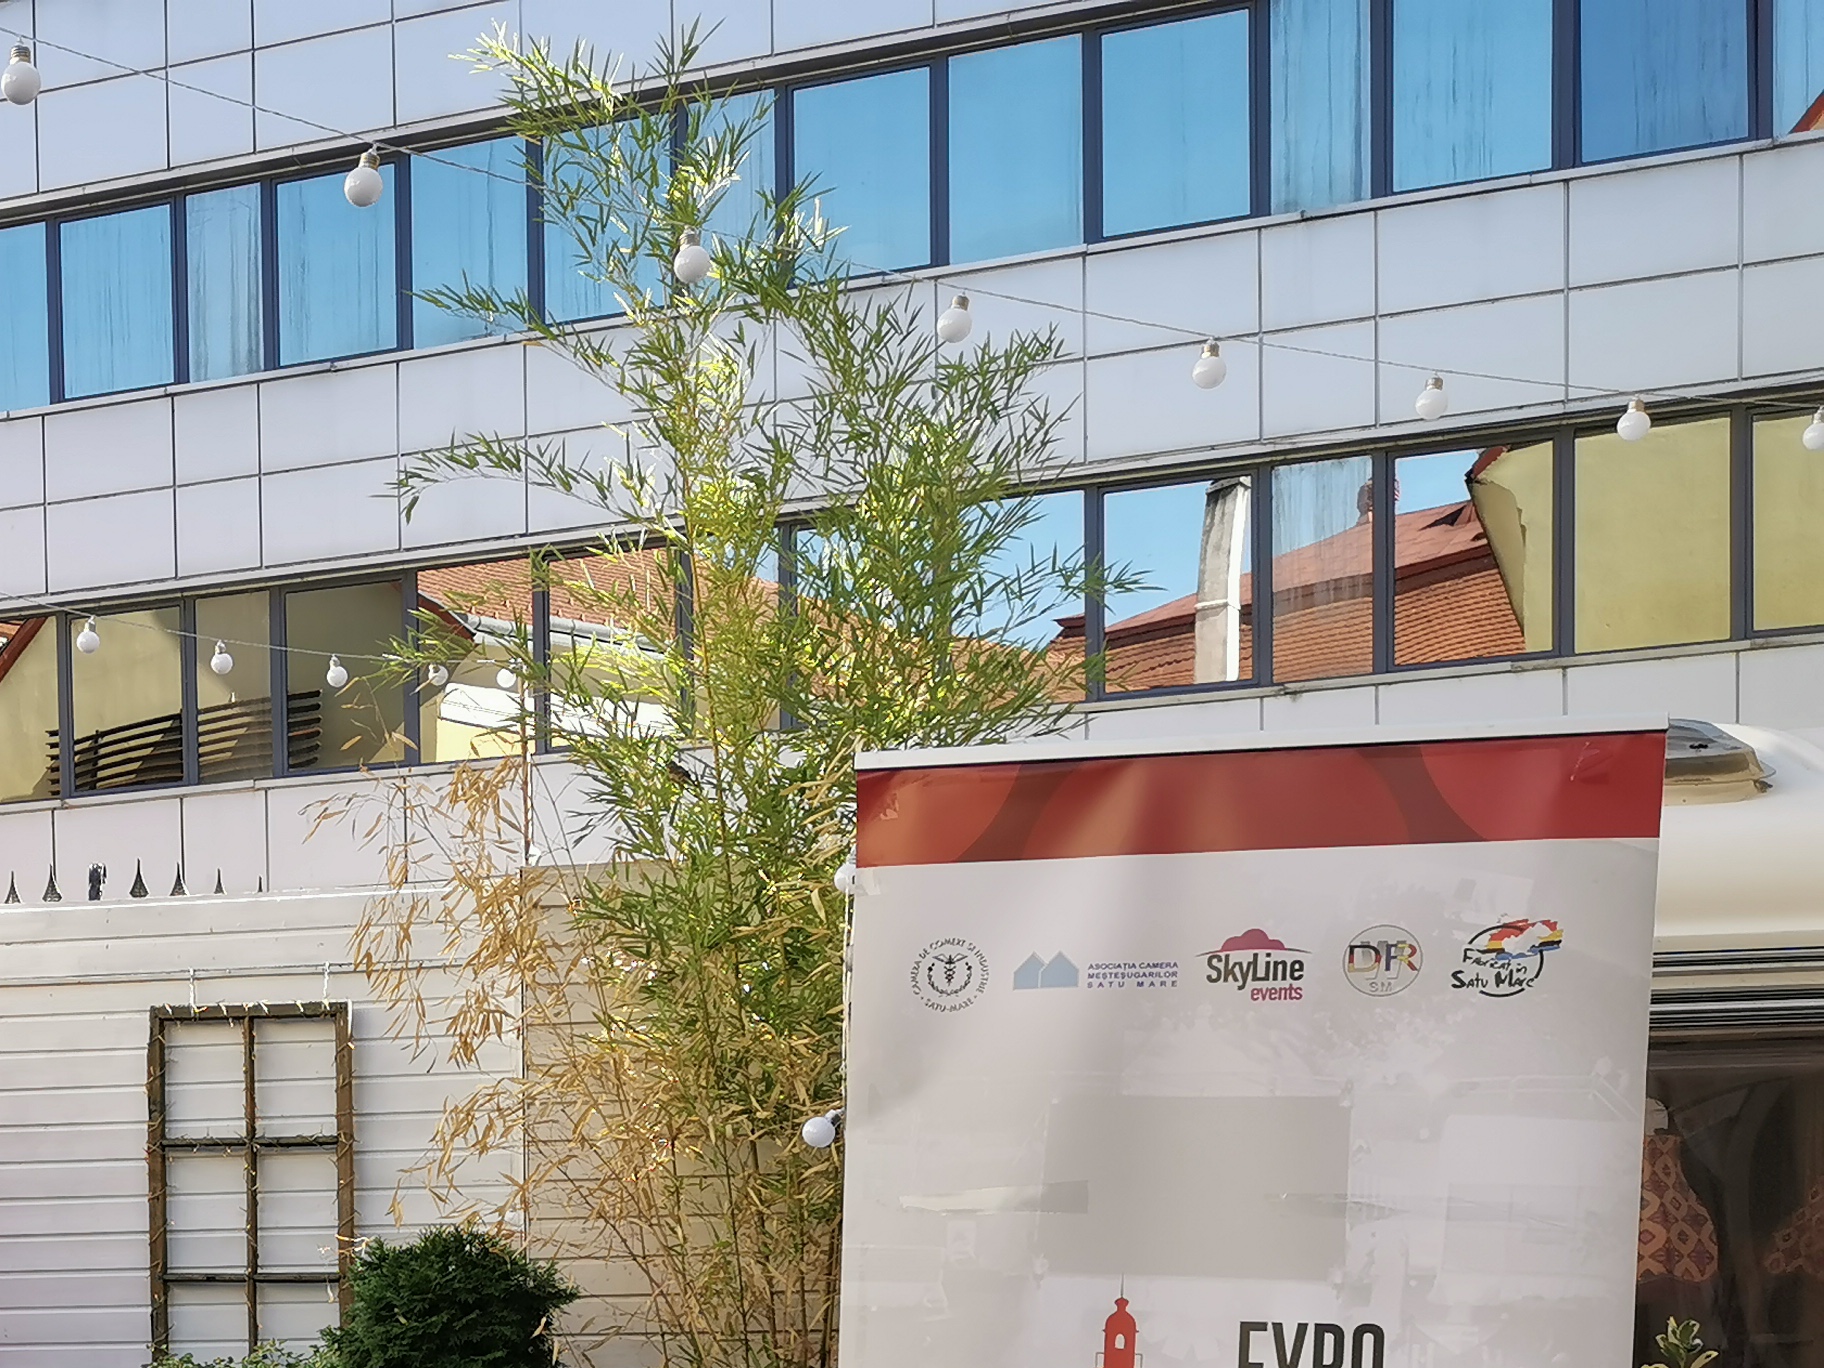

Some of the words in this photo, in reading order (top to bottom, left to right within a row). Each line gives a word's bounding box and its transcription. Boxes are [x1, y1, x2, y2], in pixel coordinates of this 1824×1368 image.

[1138, 960, 1178, 969] CAMERA
[1206, 952, 1304, 990] SkyLine
[1087, 980, 1125, 988] SATU
[1136, 980, 1178, 988] MARE
[1451, 970, 1489, 989] Satu
[1494, 968, 1536, 989] Mare
[1251, 984, 1303, 1001] events
